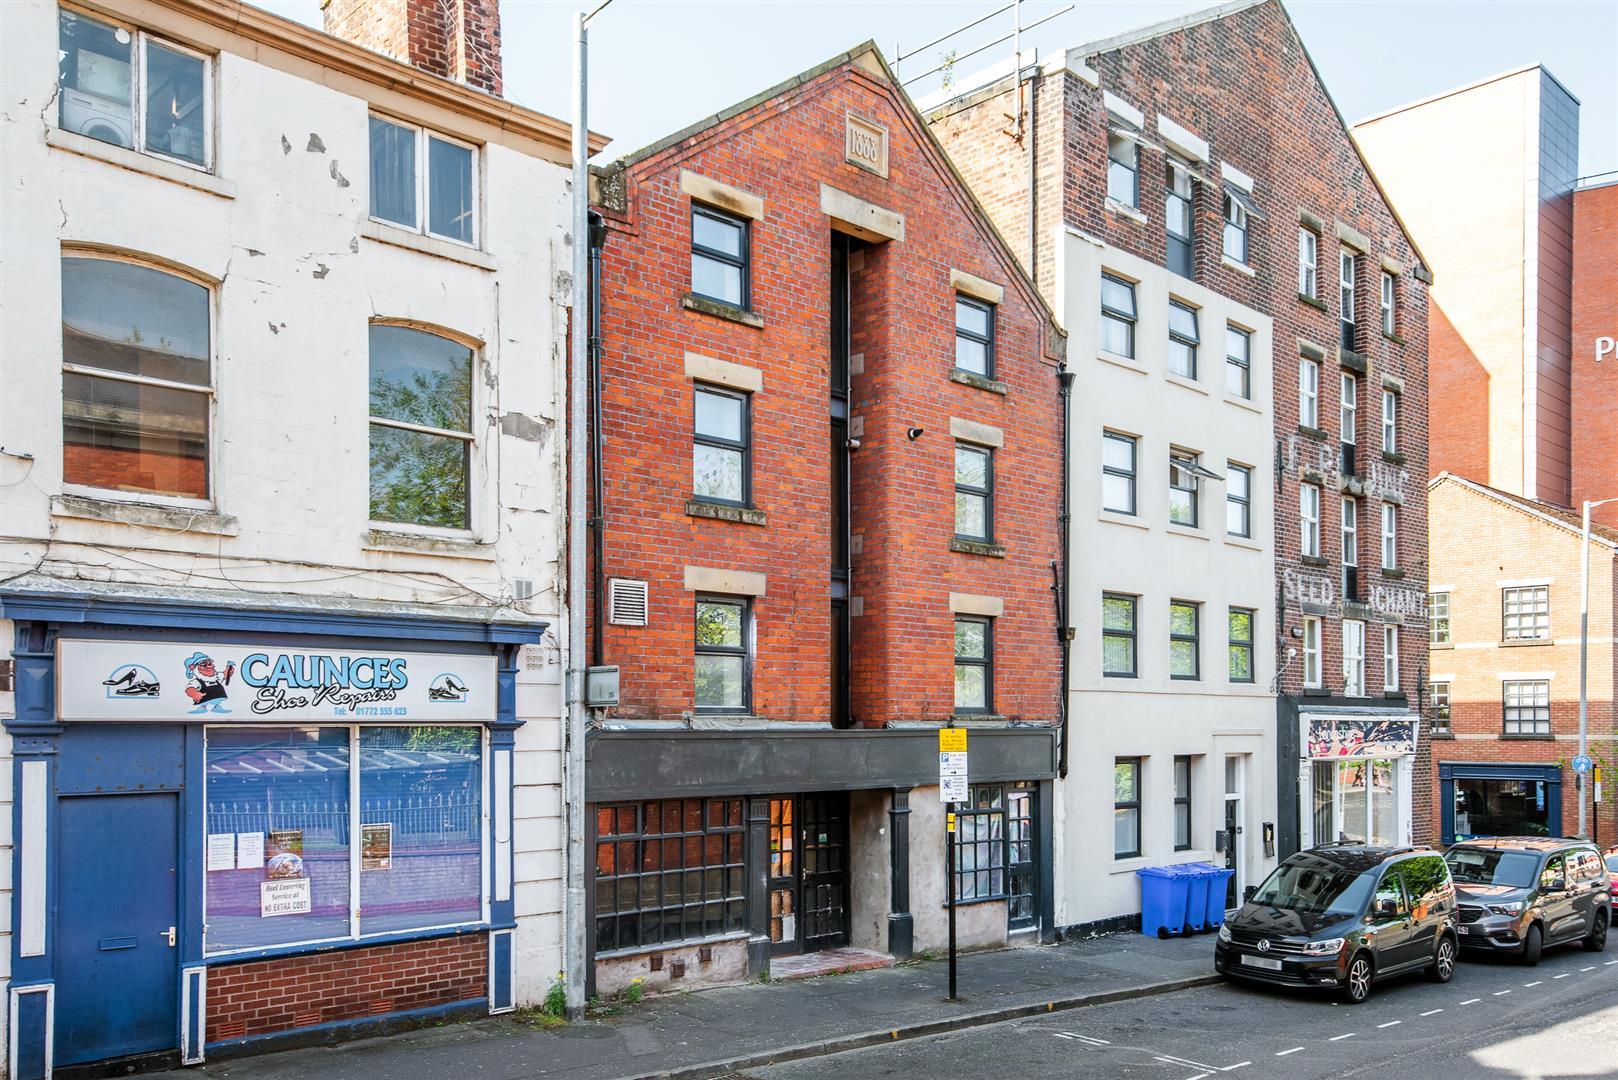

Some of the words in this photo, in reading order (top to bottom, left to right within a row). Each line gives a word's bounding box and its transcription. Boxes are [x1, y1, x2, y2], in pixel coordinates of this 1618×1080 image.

[851, 128, 877, 162] 1888
[1595, 336, 1618, 361] P
[1283, 568, 1333, 604] SEED
[241, 653, 408, 689] CAUNCES
[251, 687, 308, 714] Shoe
[312, 683, 396, 711] Repairs
[356, 707, 378, 716] 01772
[379, 707, 393, 716] 555
[394, 707, 407, 716] 623
[271, 893, 292, 901] Service
[279, 882, 305, 892] Lowering
[273, 902, 291, 912] EXTRA
[292, 900, 307, 910] COST
